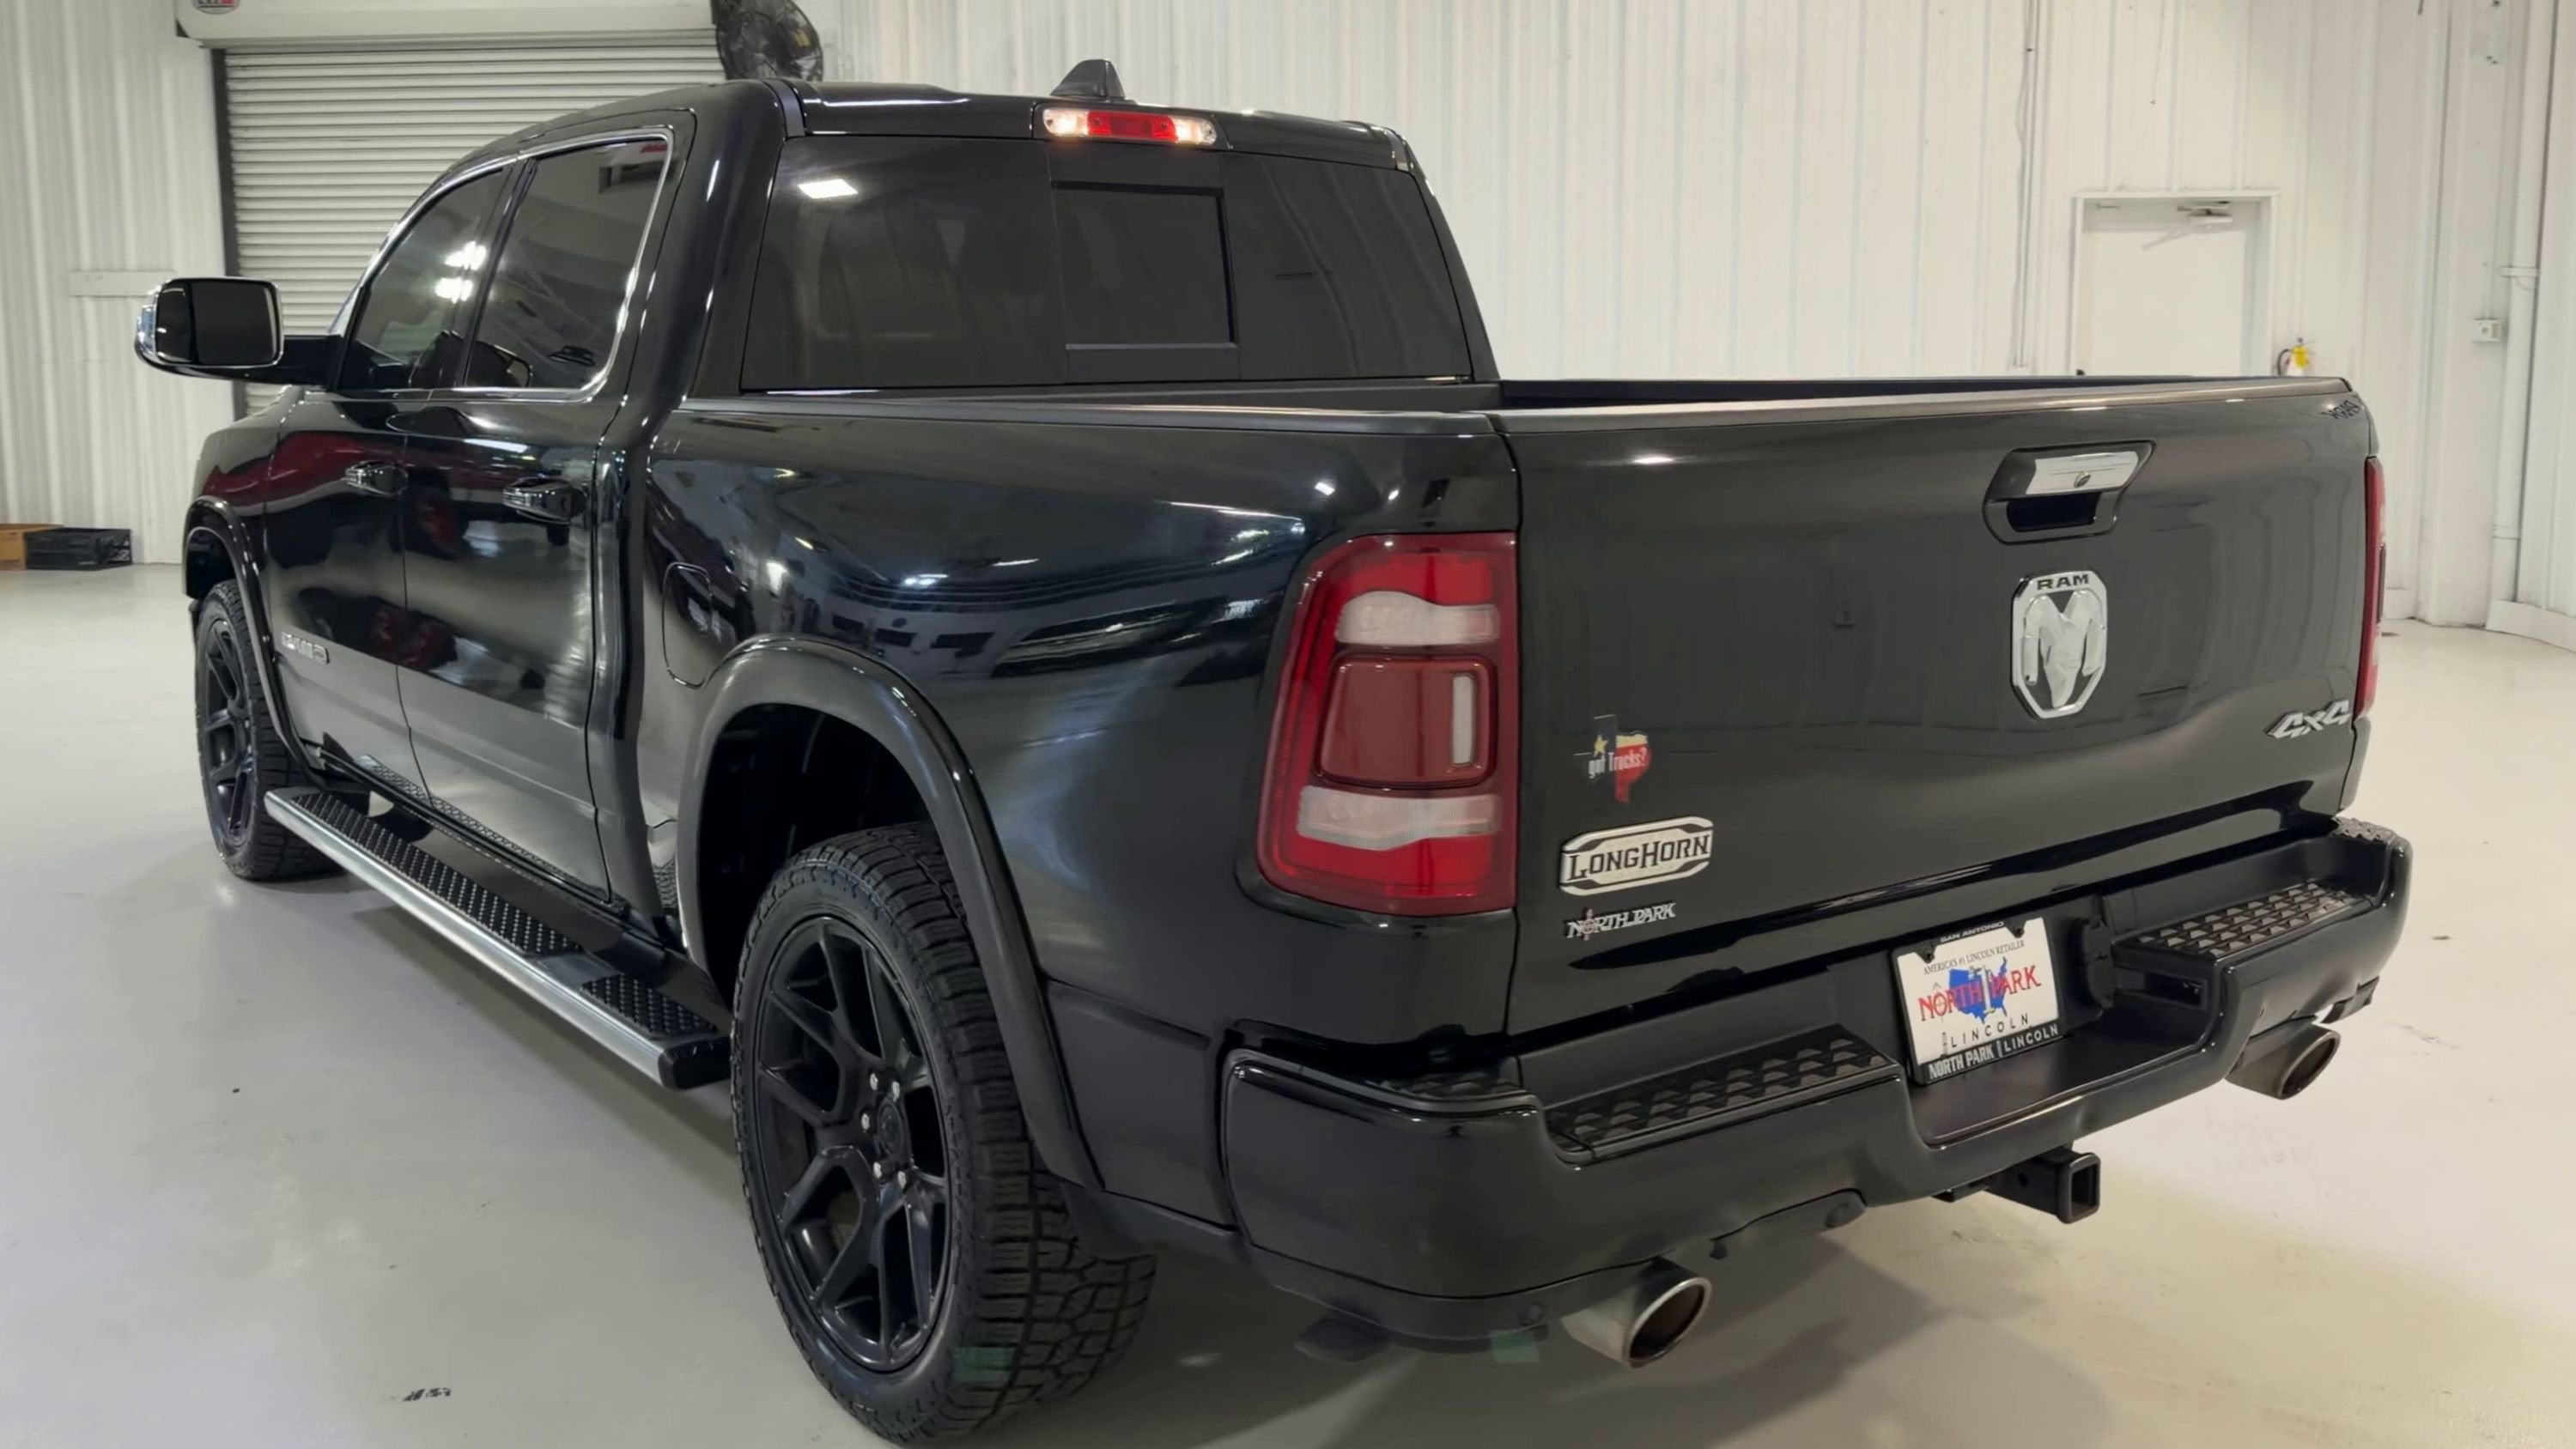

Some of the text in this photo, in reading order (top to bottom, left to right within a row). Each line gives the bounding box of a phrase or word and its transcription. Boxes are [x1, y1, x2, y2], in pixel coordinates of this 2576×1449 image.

[2037, 573, 2090, 591] RAM
[1589, 747, 1648, 779] got Trucks?
[1567, 834, 1711, 882] LONGHORN
[1940, 921, 2005, 943] SAN ANTONIO
[1966, 948, 1996, 962] LINCOLN
[1996, 939, 2026, 956] RETAILER
[1918, 965, 2042, 1022] NORTH PARK
[1951, 1013, 2029, 1048] LINCOLN
[1929, 1024, 2059, 1080] NORTH PARK LINCOLN
